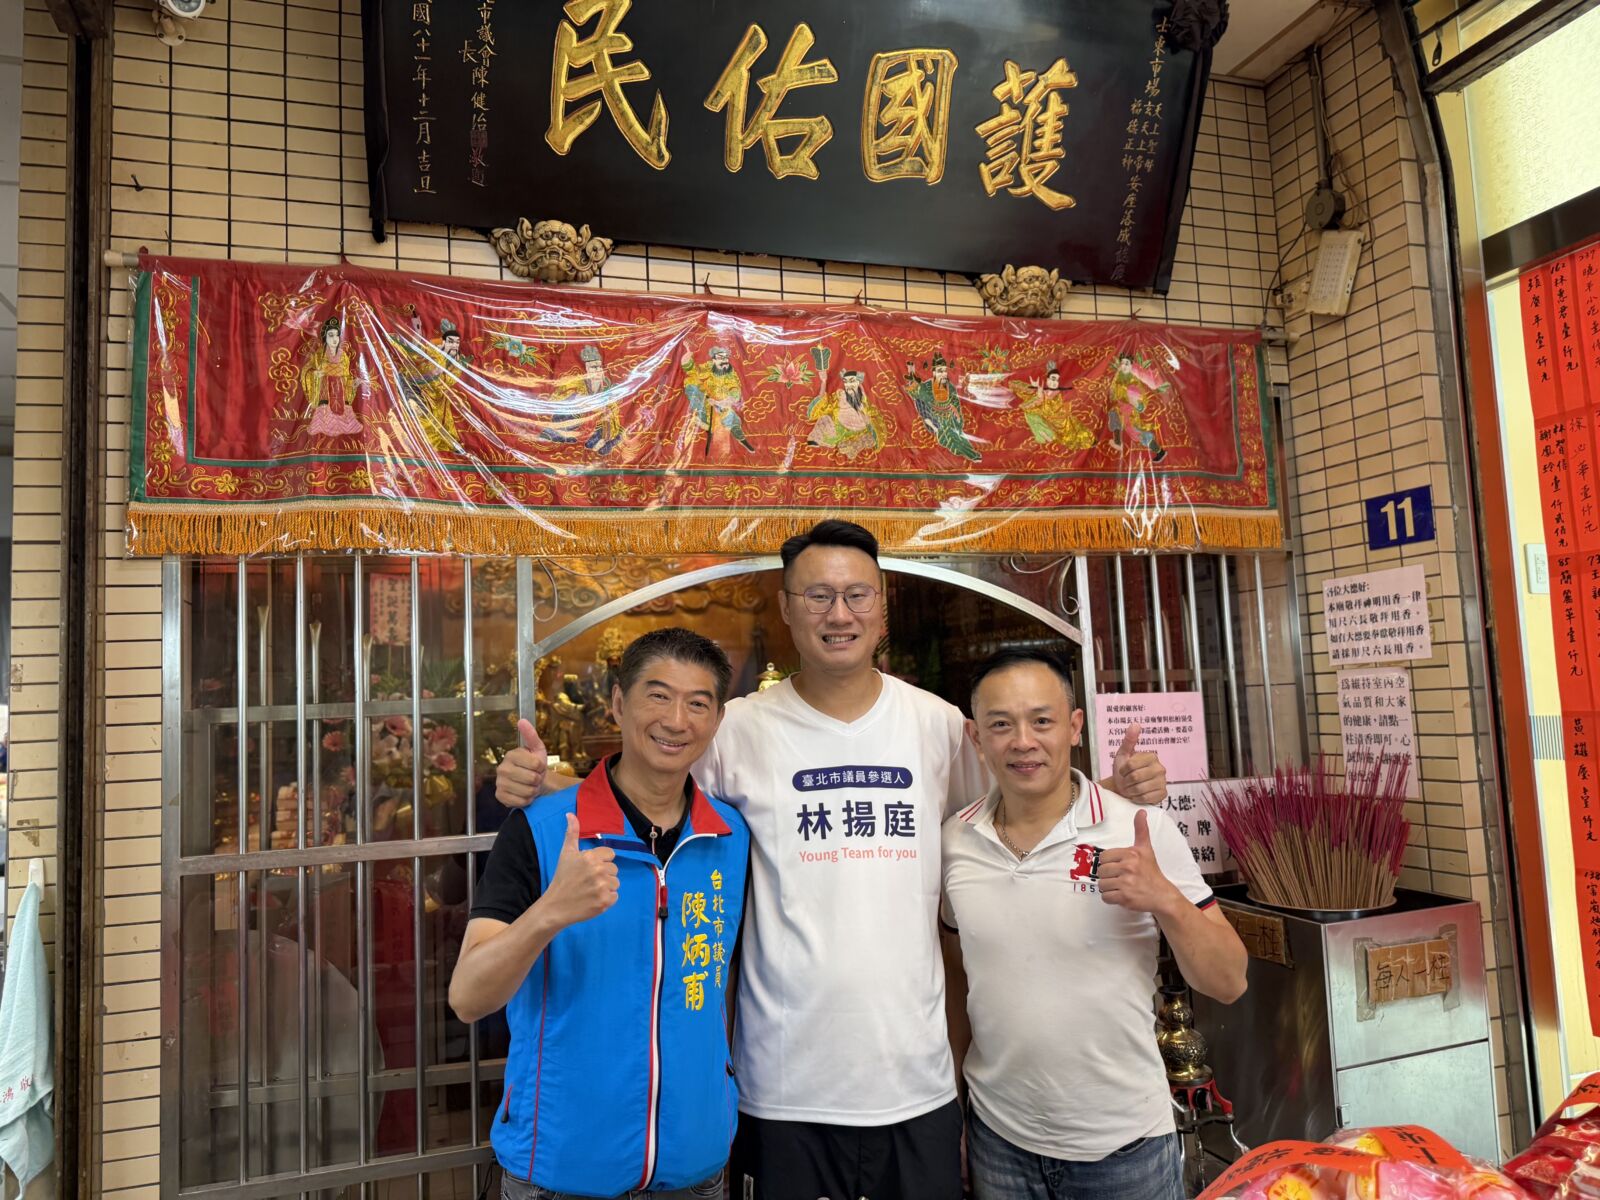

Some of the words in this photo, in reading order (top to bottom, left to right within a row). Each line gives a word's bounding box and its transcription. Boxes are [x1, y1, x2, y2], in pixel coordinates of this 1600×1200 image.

[412, 0, 437, 194] 國八十一年十二月吉旦
[1380, 497, 1416, 541] 11
[801, 770, 906, 787] 臺北市議員參選人
[796, 799, 916, 842] 林揚庭
[799, 848, 839, 863] Young
[841, 847, 875, 859] Team
[877, 845, 894, 859] for
[895, 850, 917, 863] you
[710, 869, 727, 989] 台北市議員
[681, 891, 711, 1012] 陳炳甫
